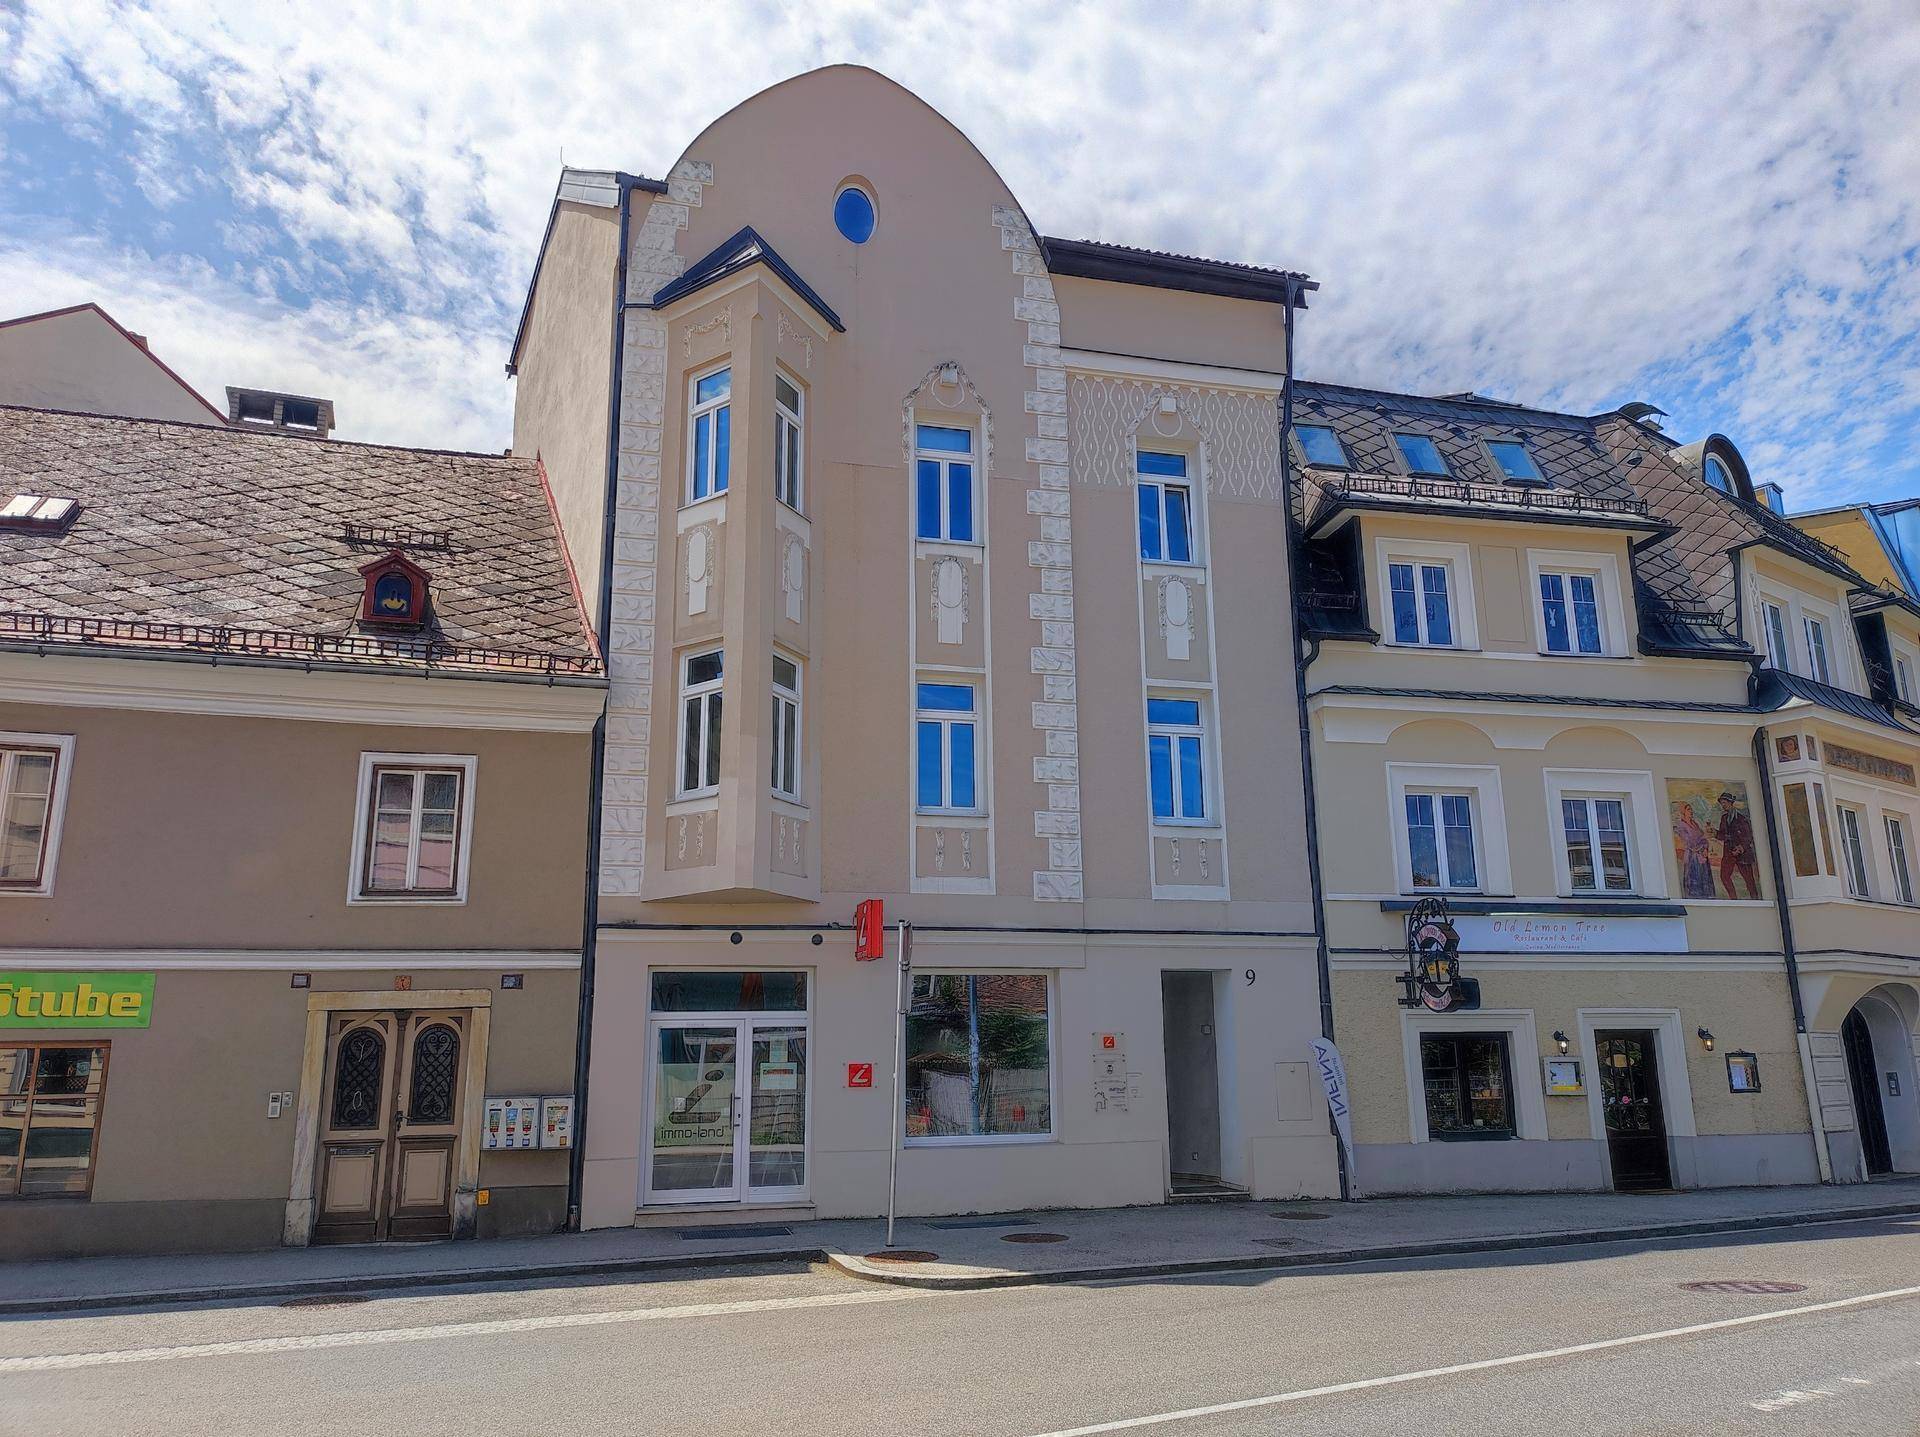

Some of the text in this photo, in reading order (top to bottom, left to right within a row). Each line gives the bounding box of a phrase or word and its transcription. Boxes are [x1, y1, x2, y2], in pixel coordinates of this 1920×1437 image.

[1493, 920, 1606, 932] Old Lemon Tree
[1514, 934, 1557, 942] Restaurant
[1560, 934, 1567, 942] &
[1245, 969, 1256, 986] 9
[661, 1126, 724, 1139] immo-land
